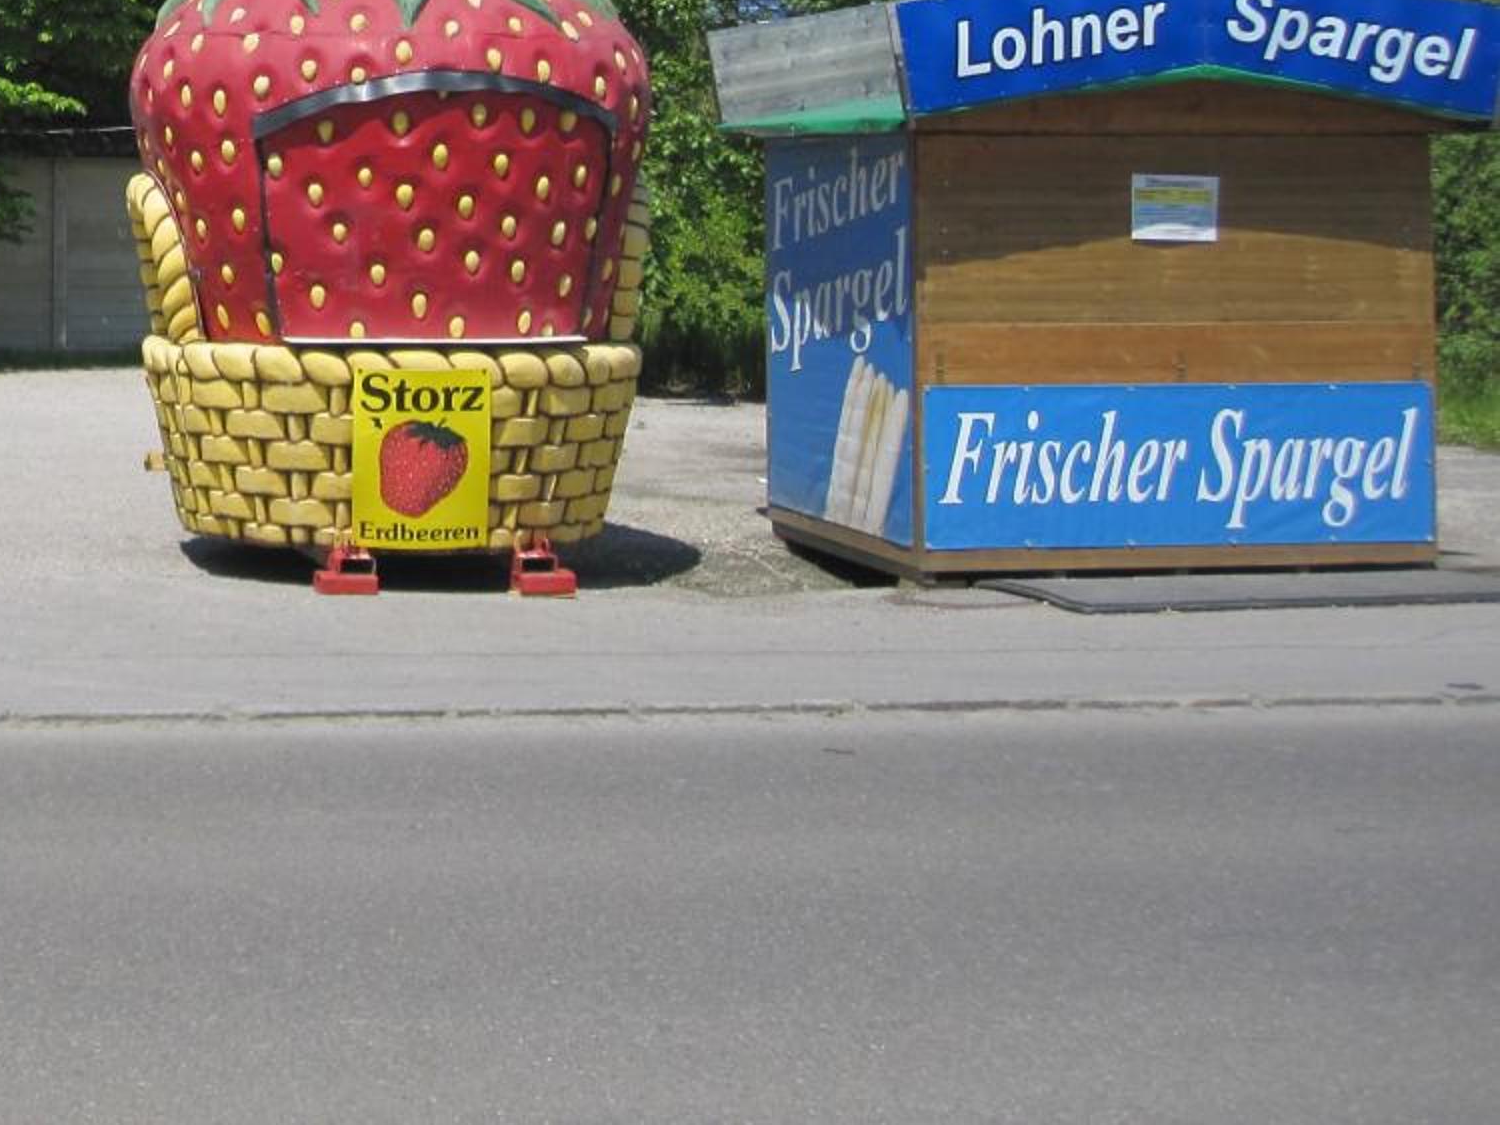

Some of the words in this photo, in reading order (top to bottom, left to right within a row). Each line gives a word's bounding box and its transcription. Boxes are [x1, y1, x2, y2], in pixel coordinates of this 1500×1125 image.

[956, 0, 1167, 77] Lohner
[772, 147, 904, 251] Frischer
[771, 227, 907, 372] Spargel
[361, 373, 484, 412] Storz
[941, 410, 1188, 506] Frischer
[1198, 408, 1417, 528] Spargel
[359, 521, 479, 542] Erdbeeren
